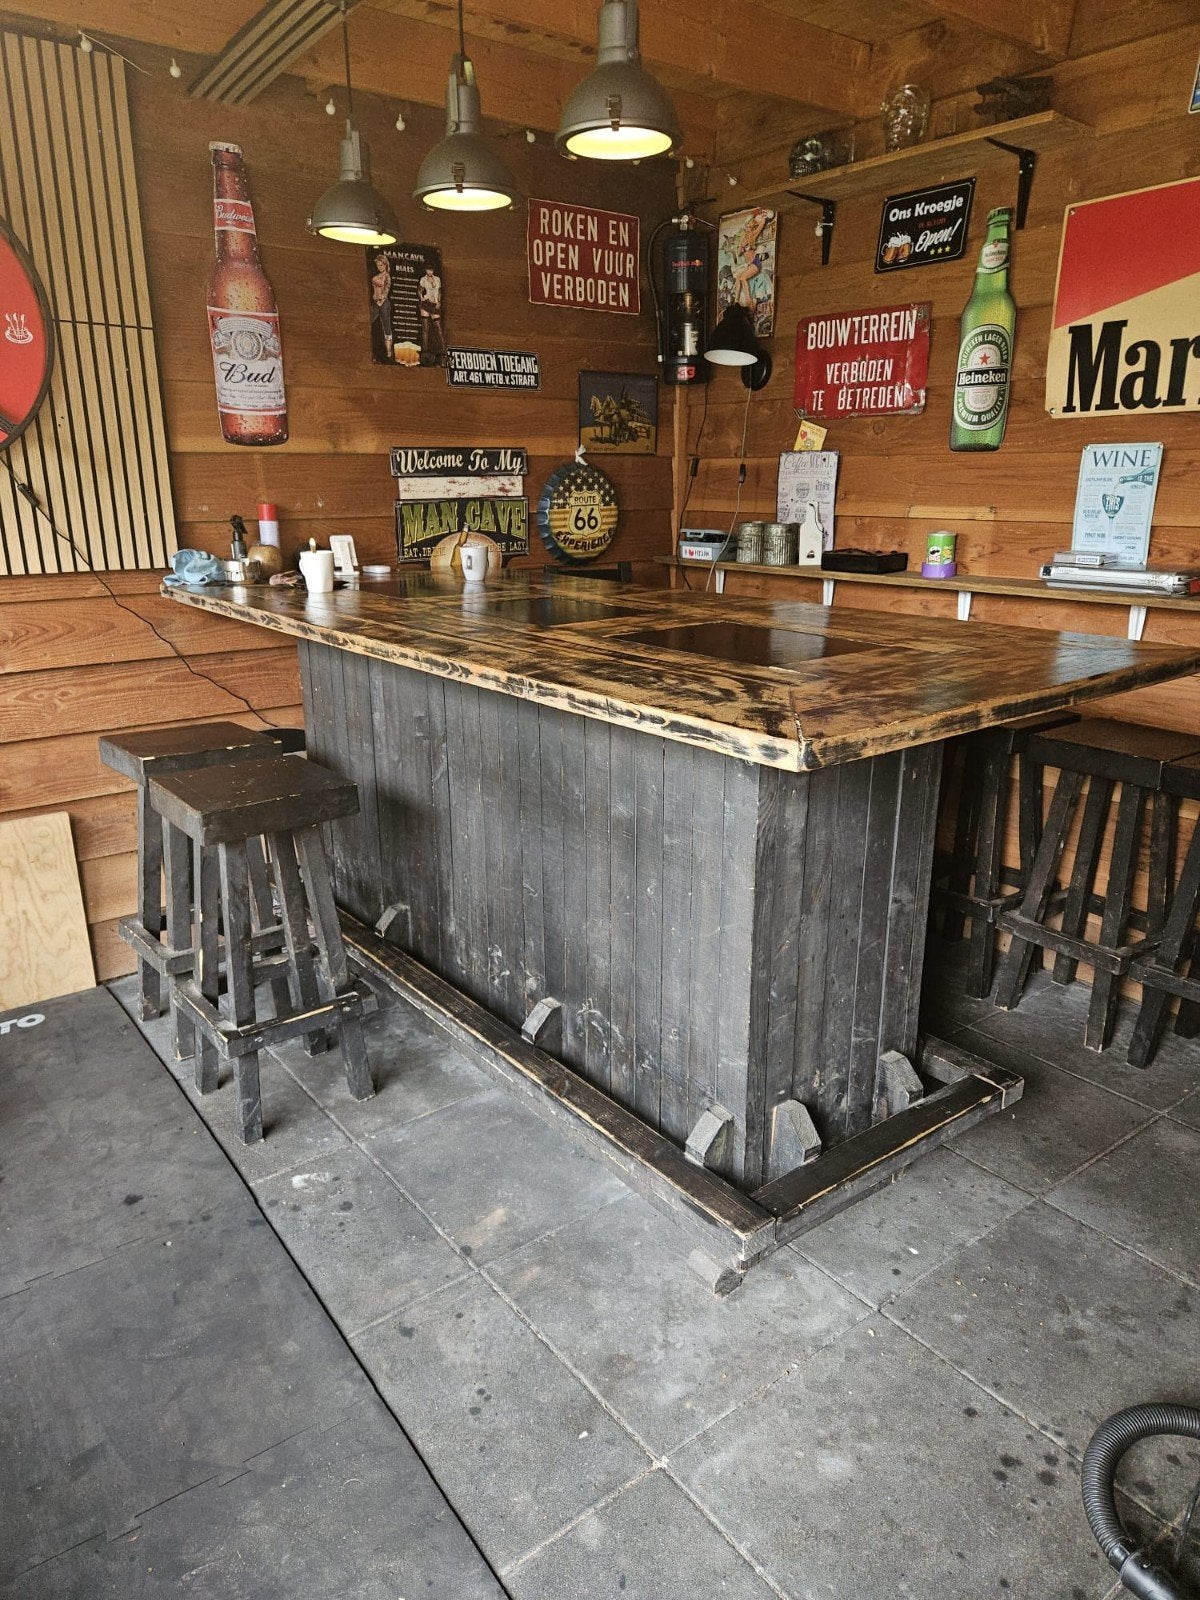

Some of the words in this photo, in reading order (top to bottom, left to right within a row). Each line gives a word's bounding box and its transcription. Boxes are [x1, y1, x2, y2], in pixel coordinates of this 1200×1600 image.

[889, 208, 912, 222] Ons
[914, 195, 964, 217] Kroegje
[540, 207, 598, 242] ROKEN
[608, 219, 629, 247] EN
[915, 217, 963, 252] Open!
[533, 239, 579, 270] OPEN
[592, 247, 635, 278] VUUR
[540, 271, 629, 308] VERBODEN
[807, 309, 918, 350] BOUWTERREIN
[961, 335, 983, 367] HEINEKEN
[984, 333, 1002, 343] LAGER
[220, 361, 276, 384] Bud
[498, 354, 539, 374] TOEGANG
[826, 359, 893, 385] VERBODEN
[1062, 319, 1200, 413] Mar
[958, 371, 1007, 385] Heineken
[812, 390, 825, 411] TE
[837, 385, 905, 410] BETREDEN
[957, 396, 979, 423] PREMIUM
[981, 397, 1004, 422] QUALITY
[396, 449, 464, 474] Welcome
[468, 449, 489, 471] To
[494, 449, 523, 475] My
[1093, 449, 1152, 468] WINE
[574, 496, 597, 505] ROUTE
[402, 500, 459, 547] MAN
[465, 500, 526, 540] CAVE
[574, 507, 599, 531] 66
[0, 1013, 46, 1035] TO
